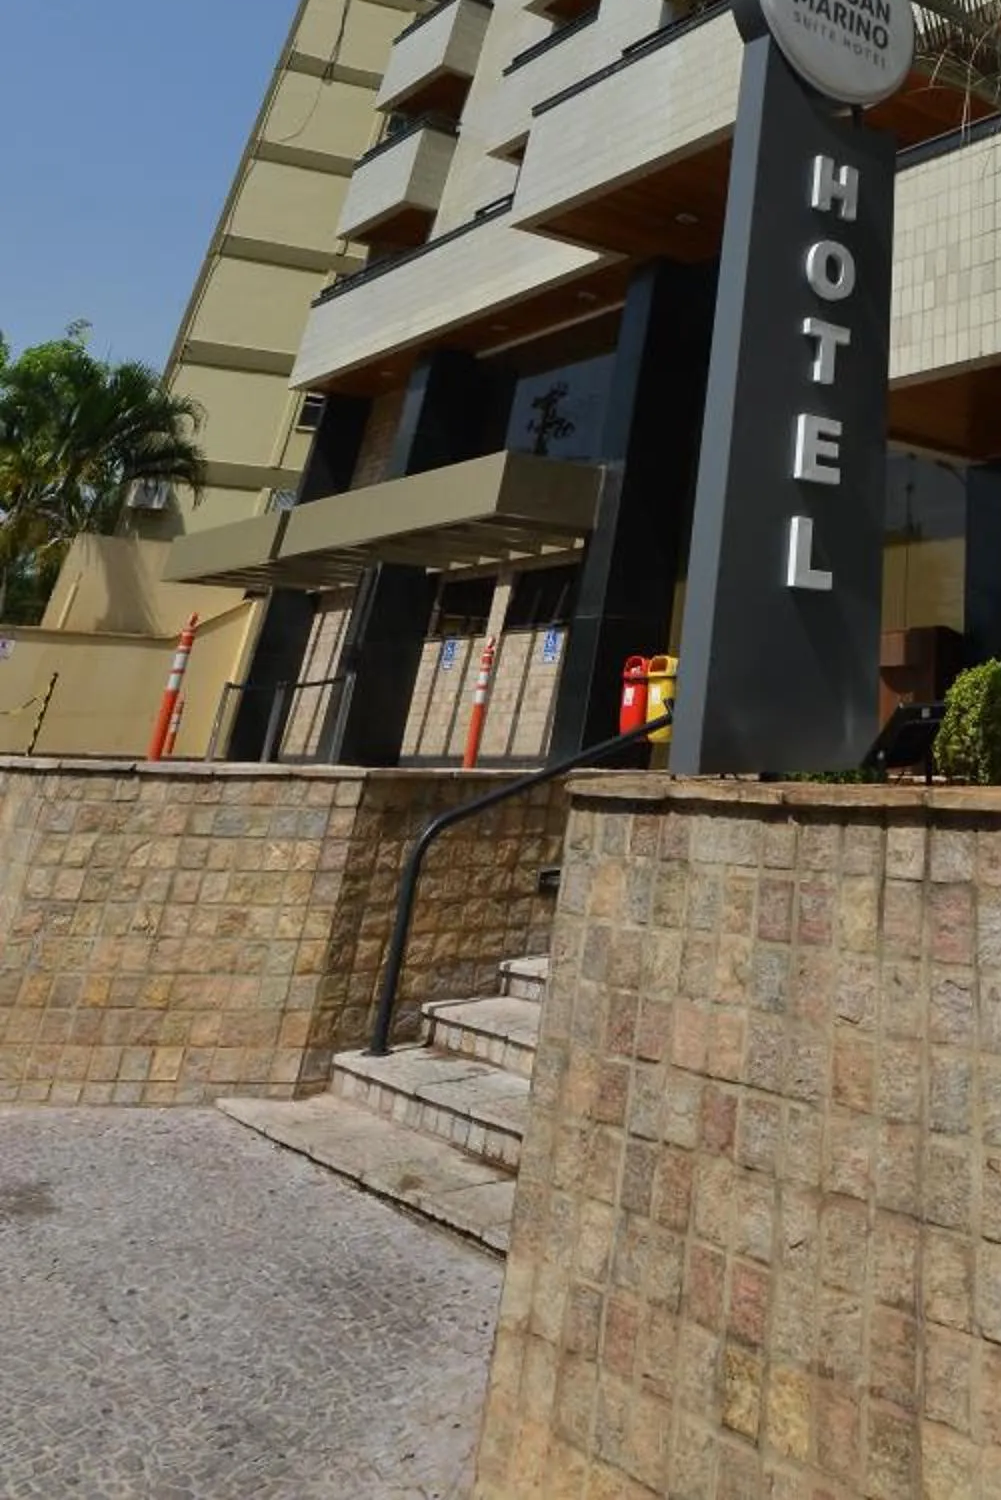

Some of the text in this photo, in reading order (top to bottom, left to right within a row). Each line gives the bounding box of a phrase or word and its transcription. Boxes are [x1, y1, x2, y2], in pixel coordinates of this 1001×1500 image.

[793, 10, 886, 70] SUITE HOTEL
[786, 155, 859, 591] HOTEL
